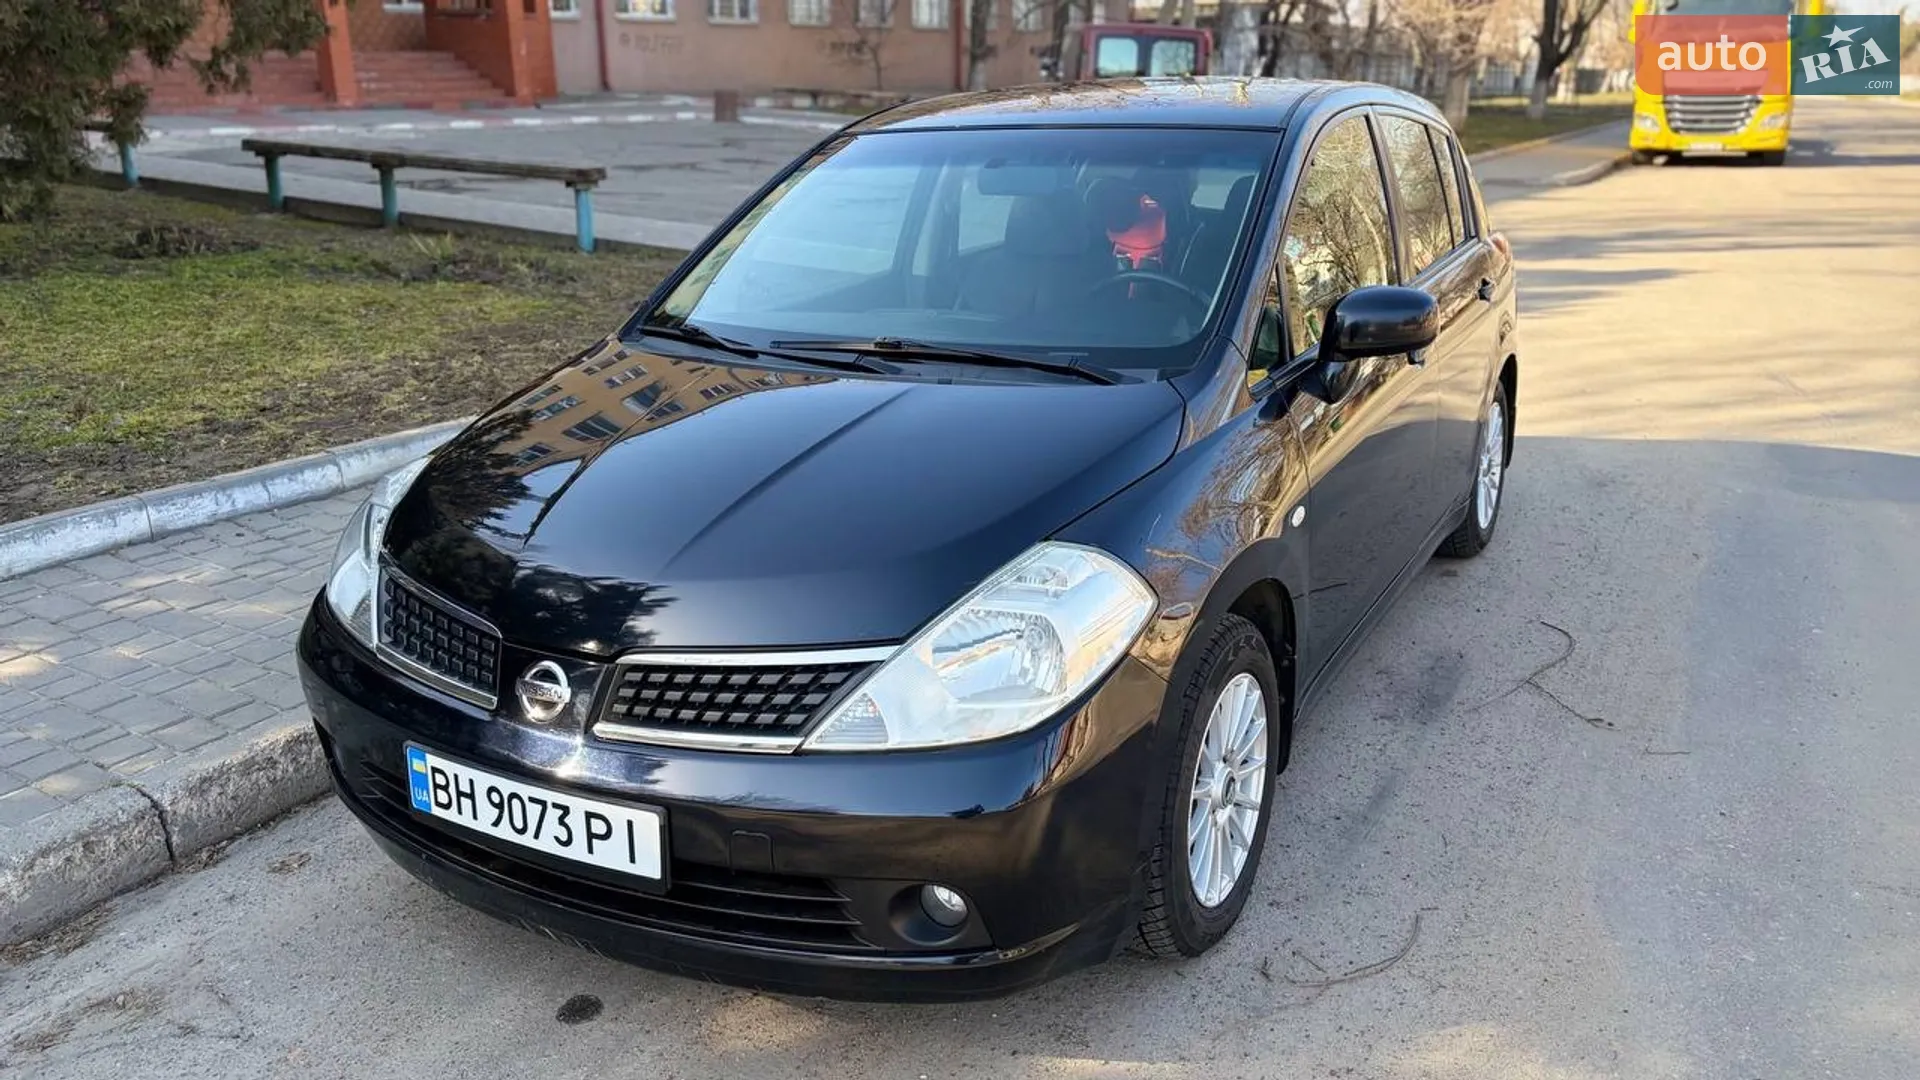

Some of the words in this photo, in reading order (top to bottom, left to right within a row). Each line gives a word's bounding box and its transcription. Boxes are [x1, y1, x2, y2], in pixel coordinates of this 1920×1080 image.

[415, 787, 429, 803] UA
[431, 765, 478, 821] BH
[486, 785, 573, 847] 9073
